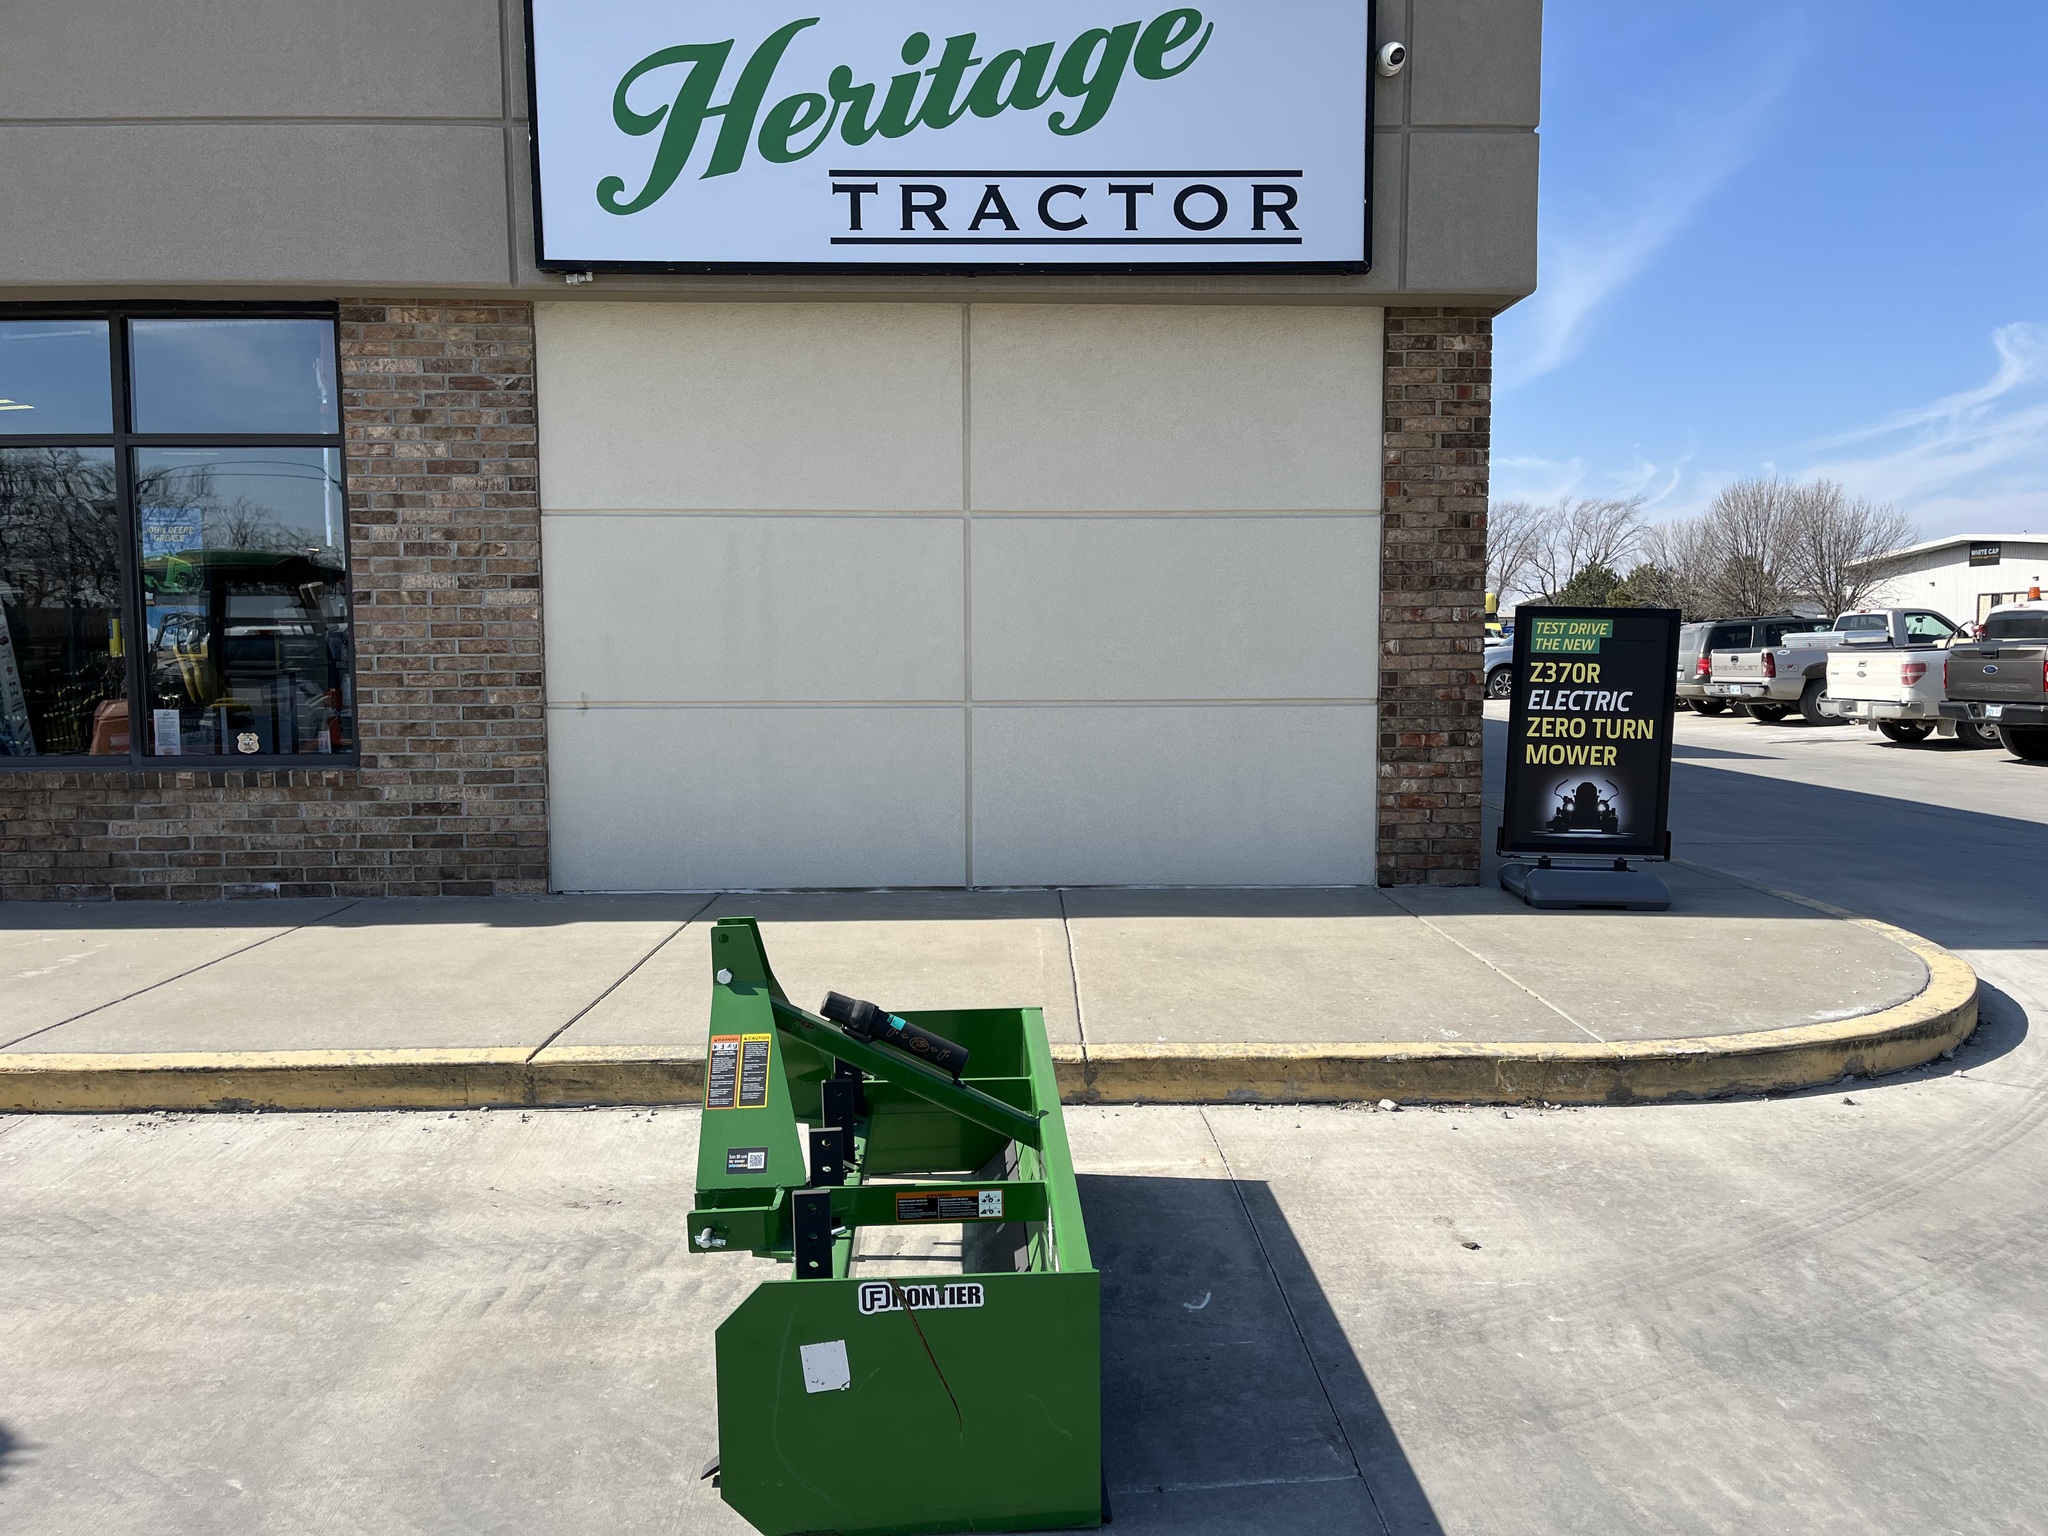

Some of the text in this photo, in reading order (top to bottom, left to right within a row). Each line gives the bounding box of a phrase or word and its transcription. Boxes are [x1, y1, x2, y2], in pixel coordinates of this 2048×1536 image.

[595, 8, 1213, 216] Heritage
[832, 183, 1300, 232] TRACTOR
[1970, 547, 1999, 556] WHITE CAP
[1536, 621, 1609, 636] TEST DRIVE
[1536, 638, 1596, 651] THE NEW
[1529, 661, 1601, 684] Z370R
[1713, 664, 1759, 672] CHEVROLET
[1528, 689, 1633, 712] ELECTRIC
[1526, 716, 1654, 740] ZERO TURN
[1525, 743, 1617, 766] MOWER
